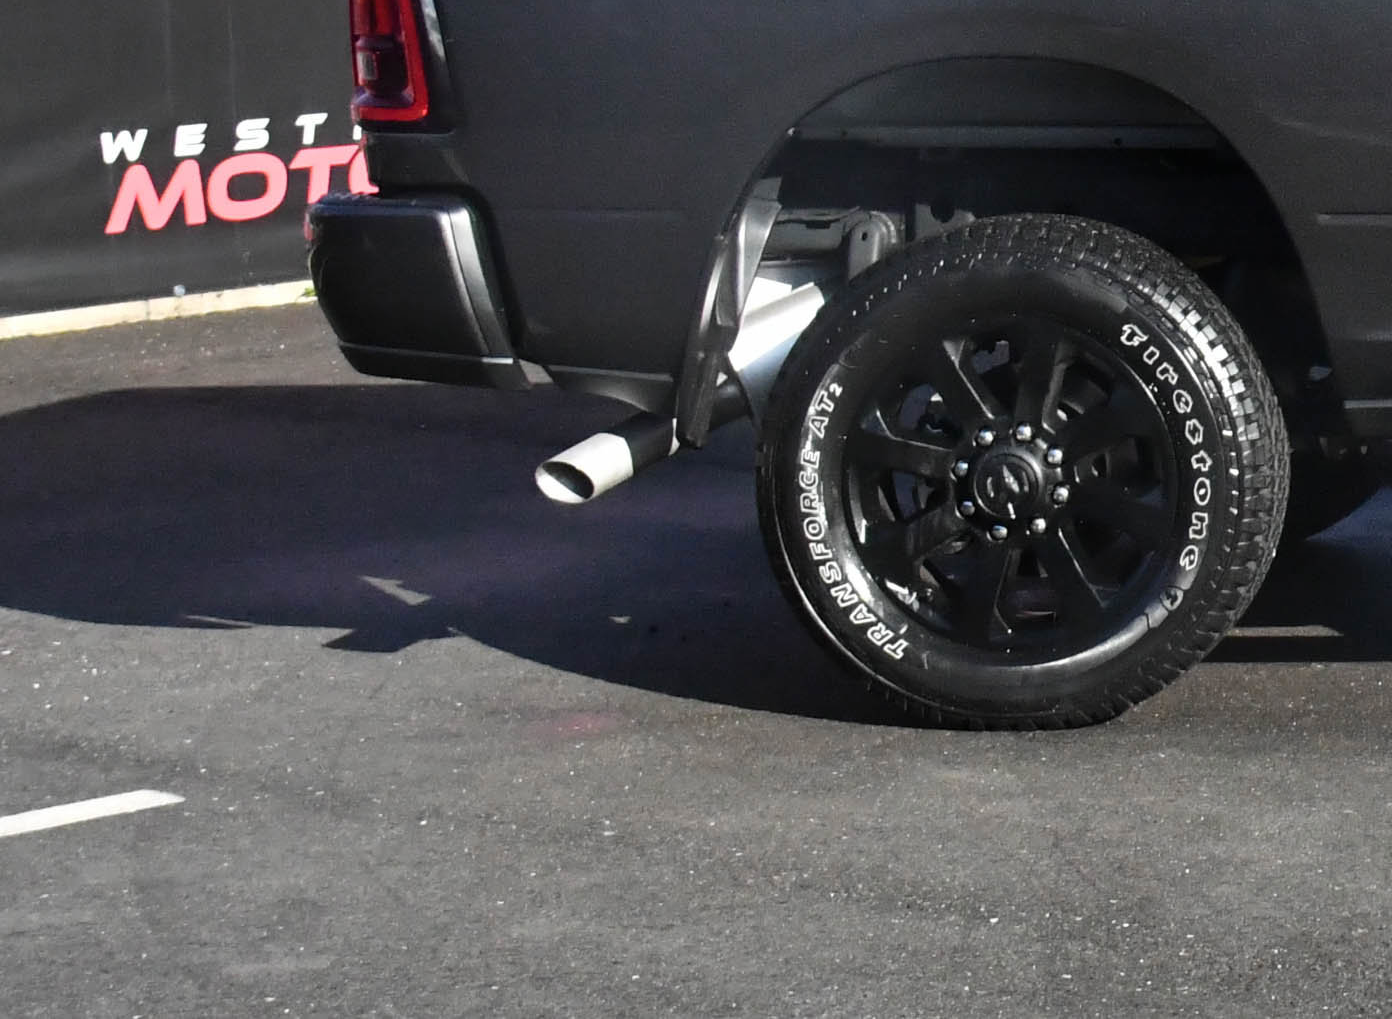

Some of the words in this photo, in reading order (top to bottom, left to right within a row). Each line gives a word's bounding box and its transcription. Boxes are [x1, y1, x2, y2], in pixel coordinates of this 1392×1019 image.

[100, 112, 363, 164] WEST
[1120, 323, 1212, 571] Firestone
[800, 448, 910, 660] TRANSFORCE
